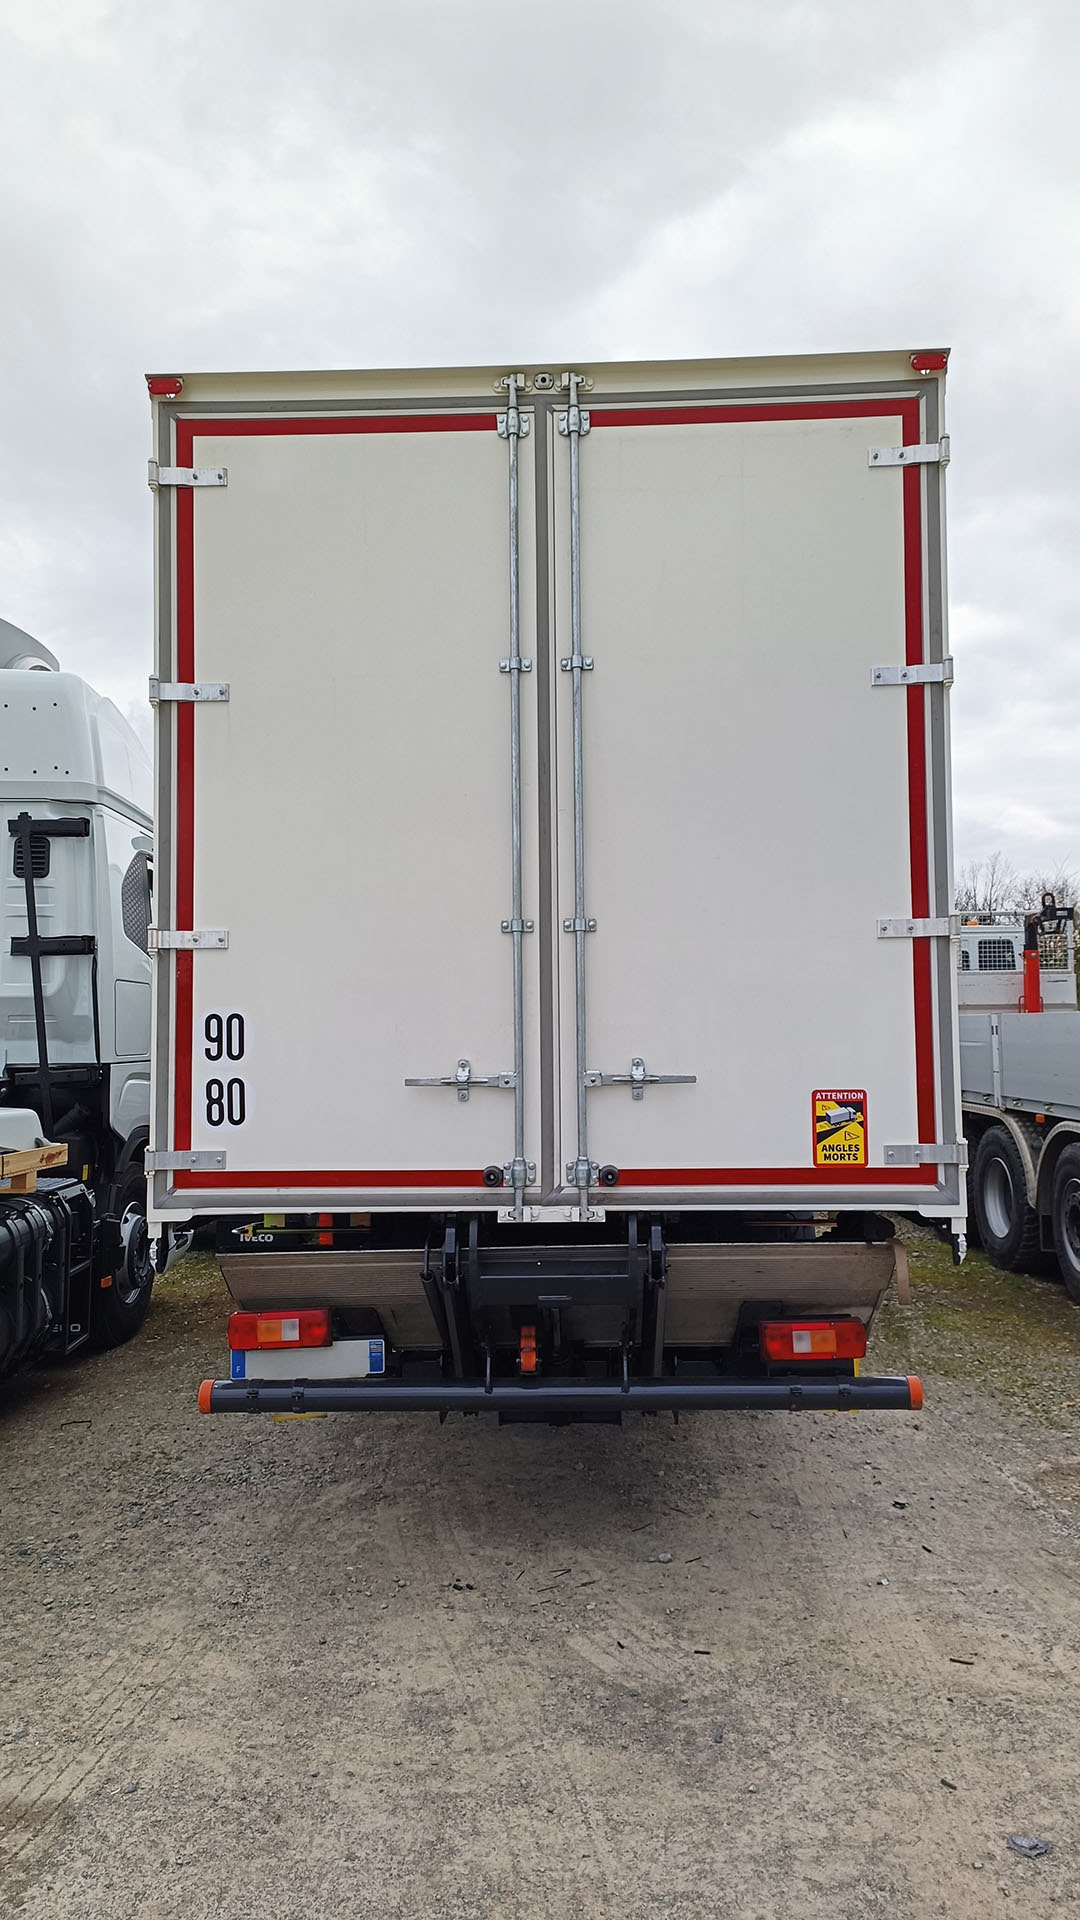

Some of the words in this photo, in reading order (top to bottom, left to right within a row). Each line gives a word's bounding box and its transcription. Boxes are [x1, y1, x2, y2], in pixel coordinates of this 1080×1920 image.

[205, 1013, 244, 1060] 90
[816, 1092, 864, 1100] ATTENTION
[206, 1078, 245, 1126] 80
[821, 1144, 860, 1152] ANGLES
[823, 1153, 859, 1161] MORTS
